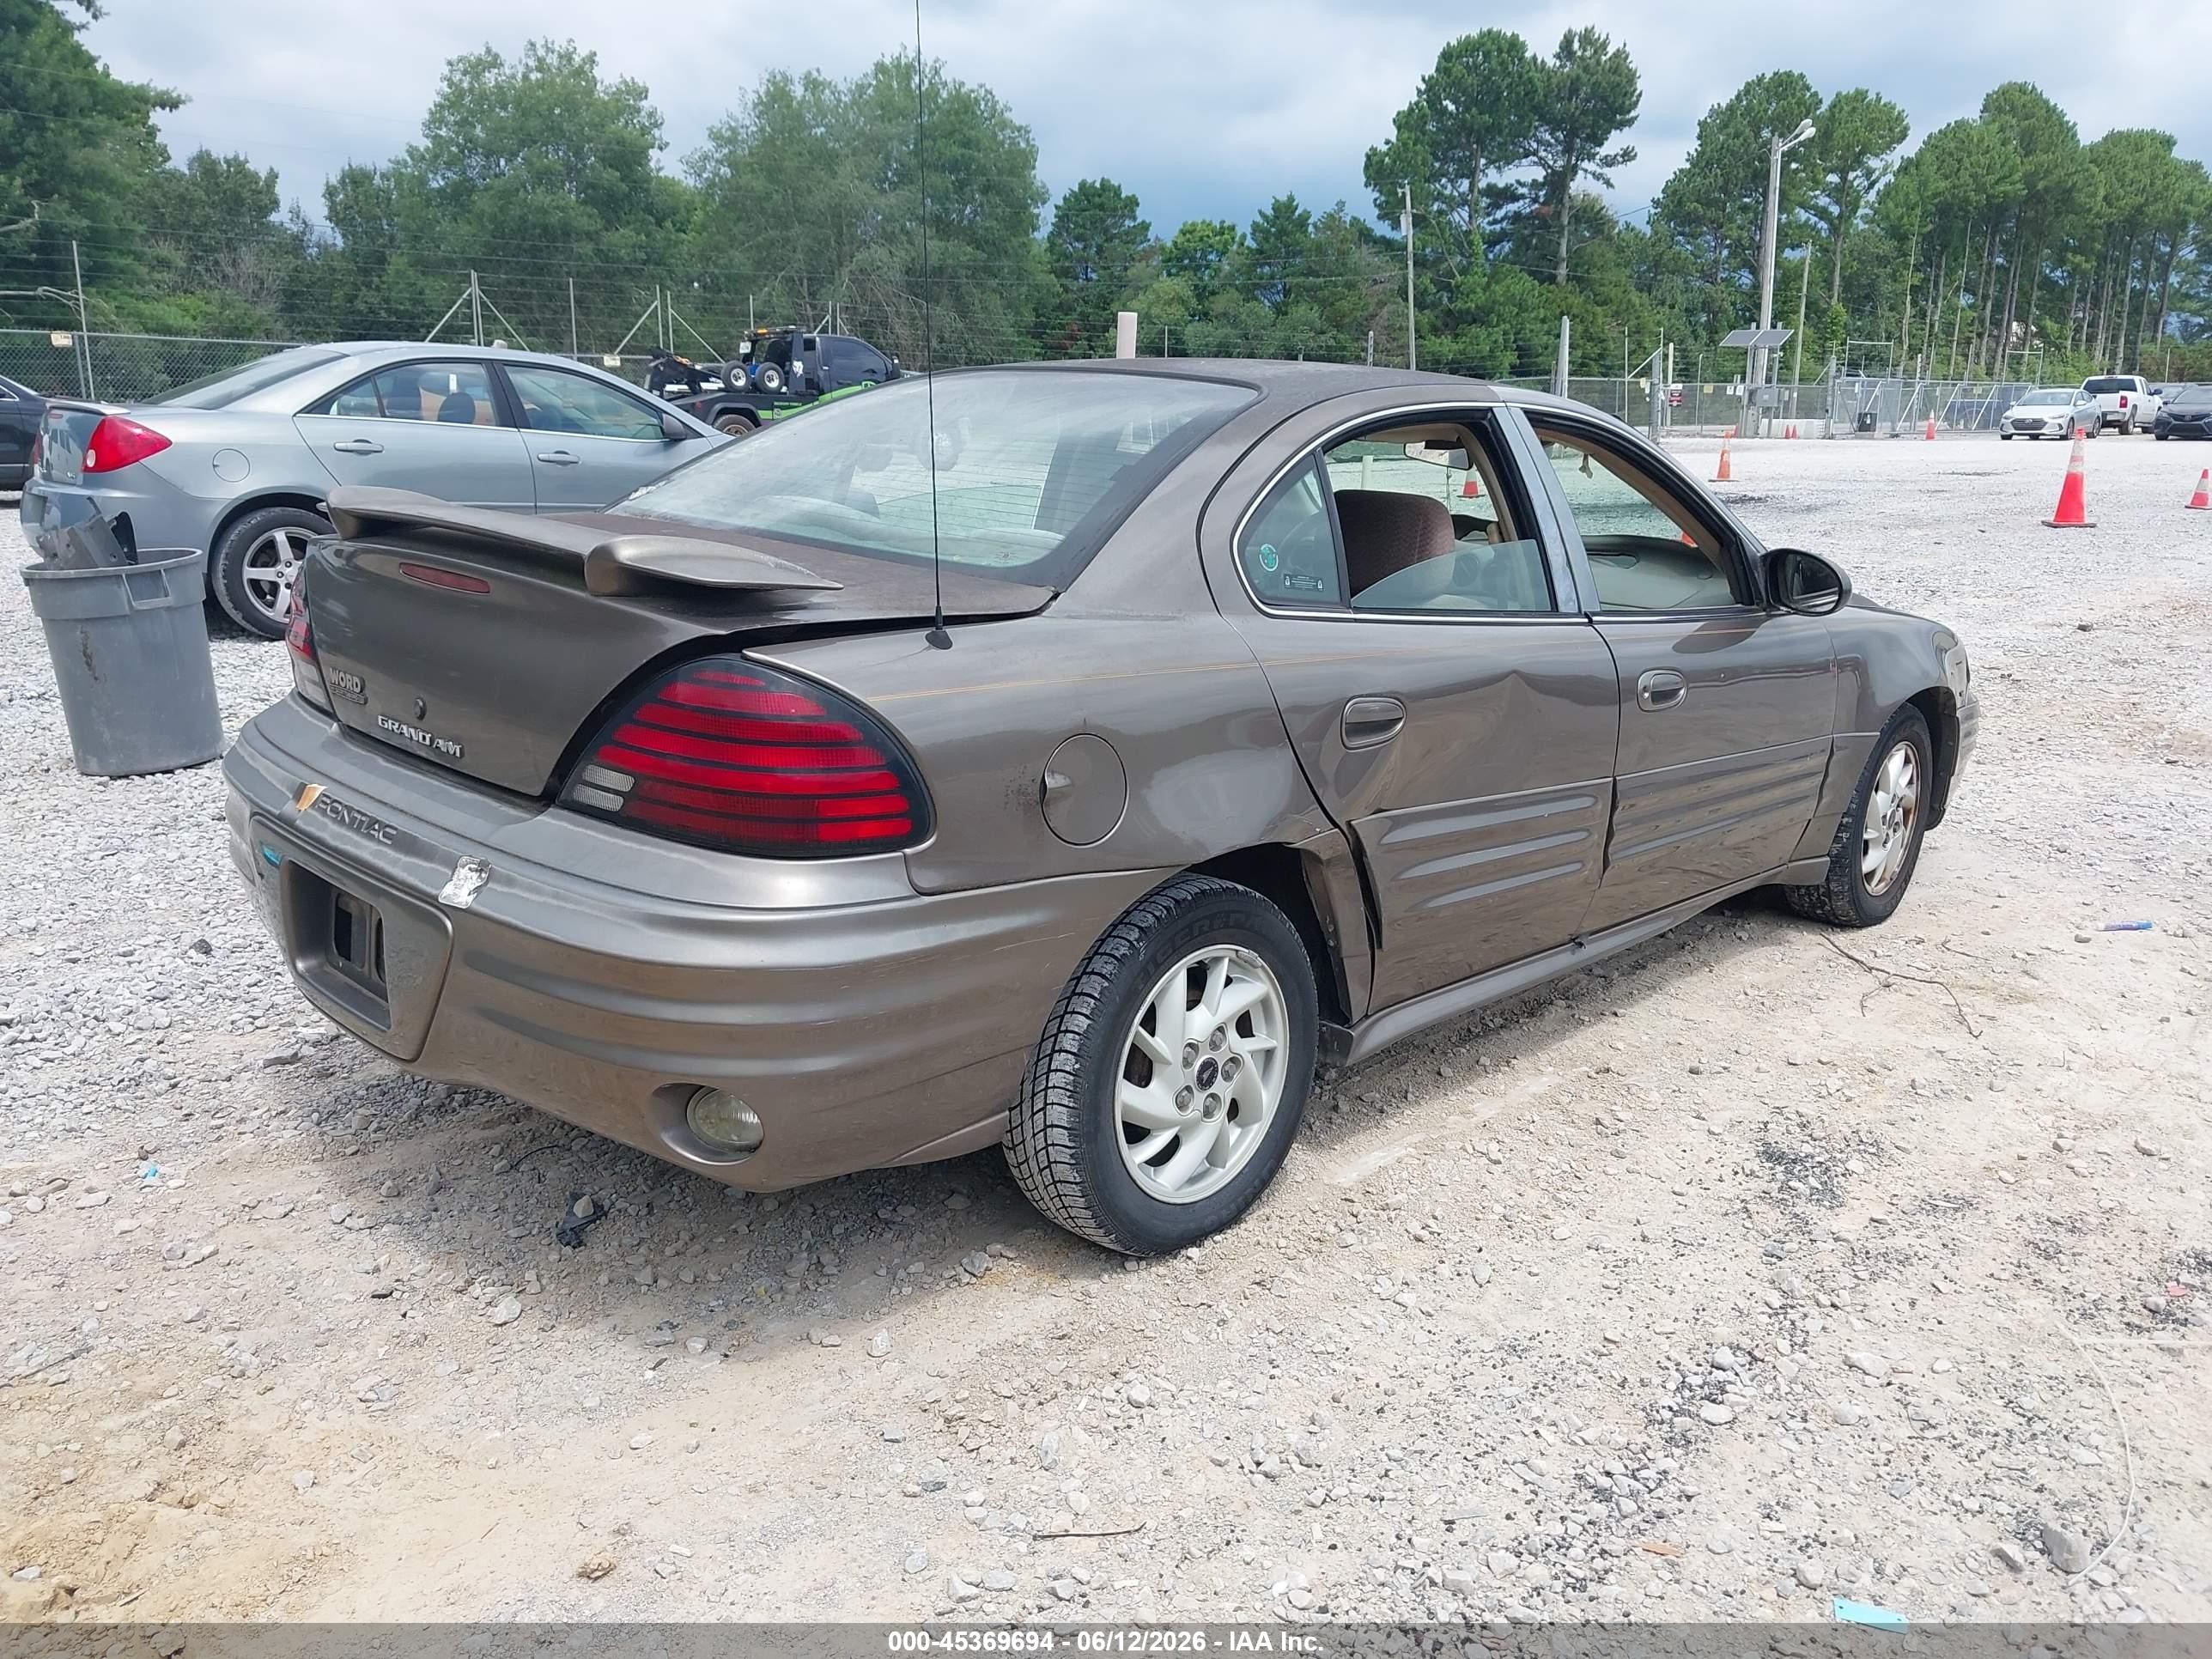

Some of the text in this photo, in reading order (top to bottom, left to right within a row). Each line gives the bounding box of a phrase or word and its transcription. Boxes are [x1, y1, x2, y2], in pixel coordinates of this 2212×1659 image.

[330, 667, 362, 694] WORD
[378, 714, 462, 757] GRAND AM
[315, 795, 397, 845] PONTIAC
